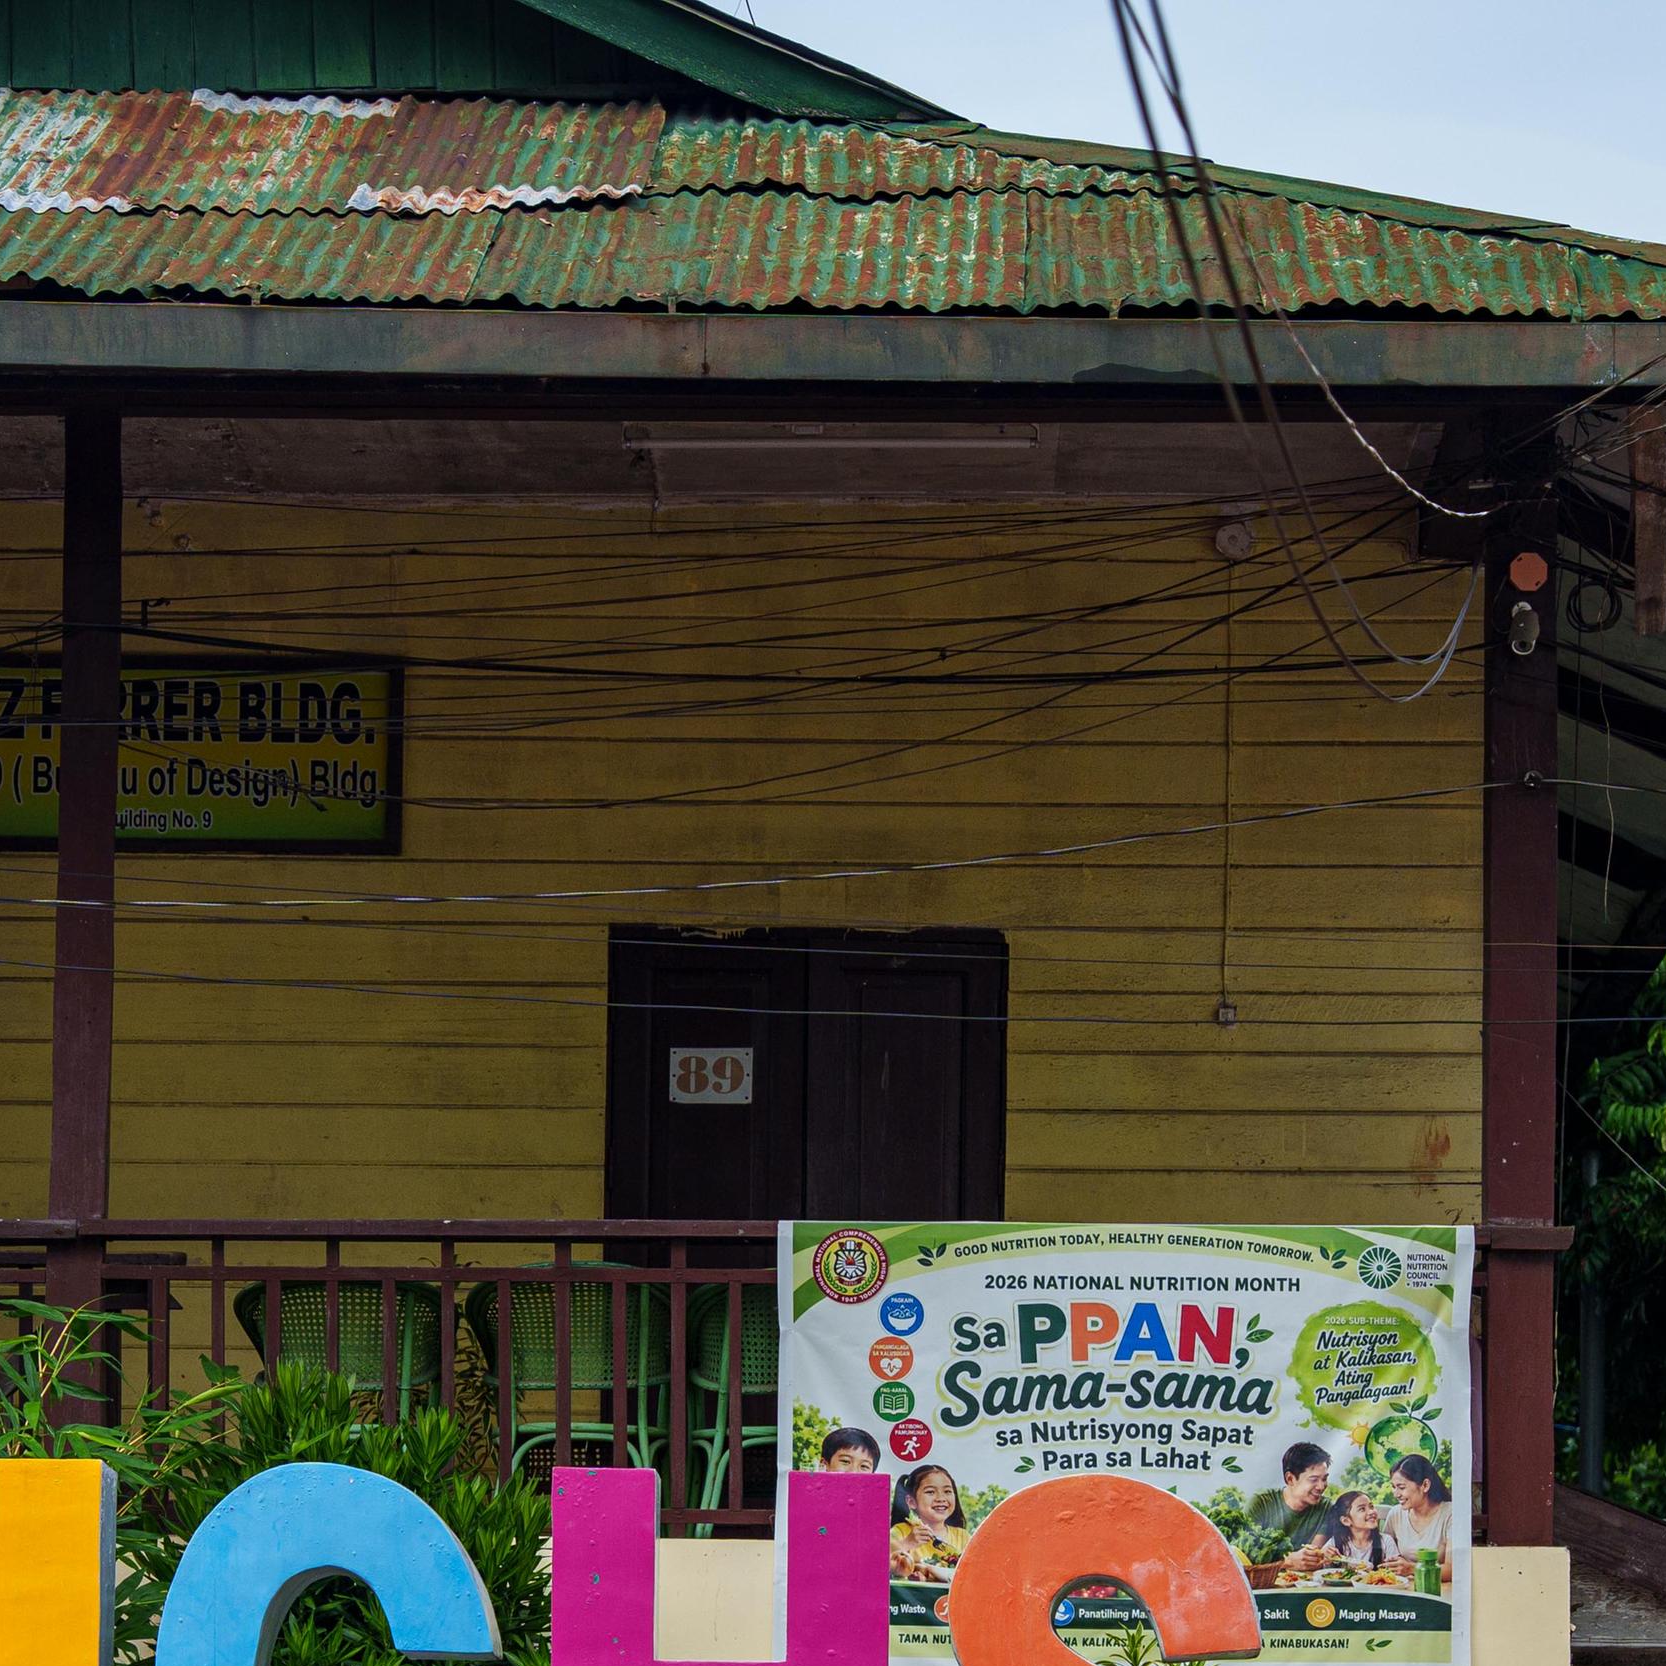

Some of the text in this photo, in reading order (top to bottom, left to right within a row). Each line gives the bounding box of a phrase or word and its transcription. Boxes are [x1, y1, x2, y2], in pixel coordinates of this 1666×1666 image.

[41, 678, 223, 742] FRER
[238, 681, 376, 745] BLDG.
[148, 757, 178, 796] of
[187, 757, 299, 808] Design)
[309, 759, 385, 809] Bldg.
[116, 808, 212, 832] uilding No. 9
[675, 1055, 746, 1095] 89
[954, 1233, 1315, 1263] GOOD NUTRITION TODAY, HEALTHY GENERATION TOMORROW.
[1406, 1263, 1448, 1271] NUTRITION
[1406, 1272, 1440, 1280] COUNCIL
[984, 1274, 1301, 1292] 2026 NATIONAL NUTRITION MONTH
[1324, 1316, 1400, 1326] 2026 SUB-THEME:
[953, 1302, 1251, 1370] Sa PPAN,
[1316, 1330, 1399, 1351] Nutrisyon
[1313, 1350, 1417, 1370] at Kalikasan,
[1334, 1370, 1374, 1388] Ating
[939, 1360, 1275, 1428] Sama-sama
[1315, 1378, 1415, 1407] Pangalagaan!
[995, 1418, 1254, 1447] sa Nutrisyong Sapat
[1042, 1447, 1212, 1472] Para sa Lahat
[900, 1603, 926, 1613] Wasto
[1263, 1608, 1290, 1620] Sakit
[1338, 1609, 1416, 1622] Maging Masaya
[898, 1633, 928, 1644] TAMA
[1269, 1638, 1350, 1649] KINABUKASAN!
